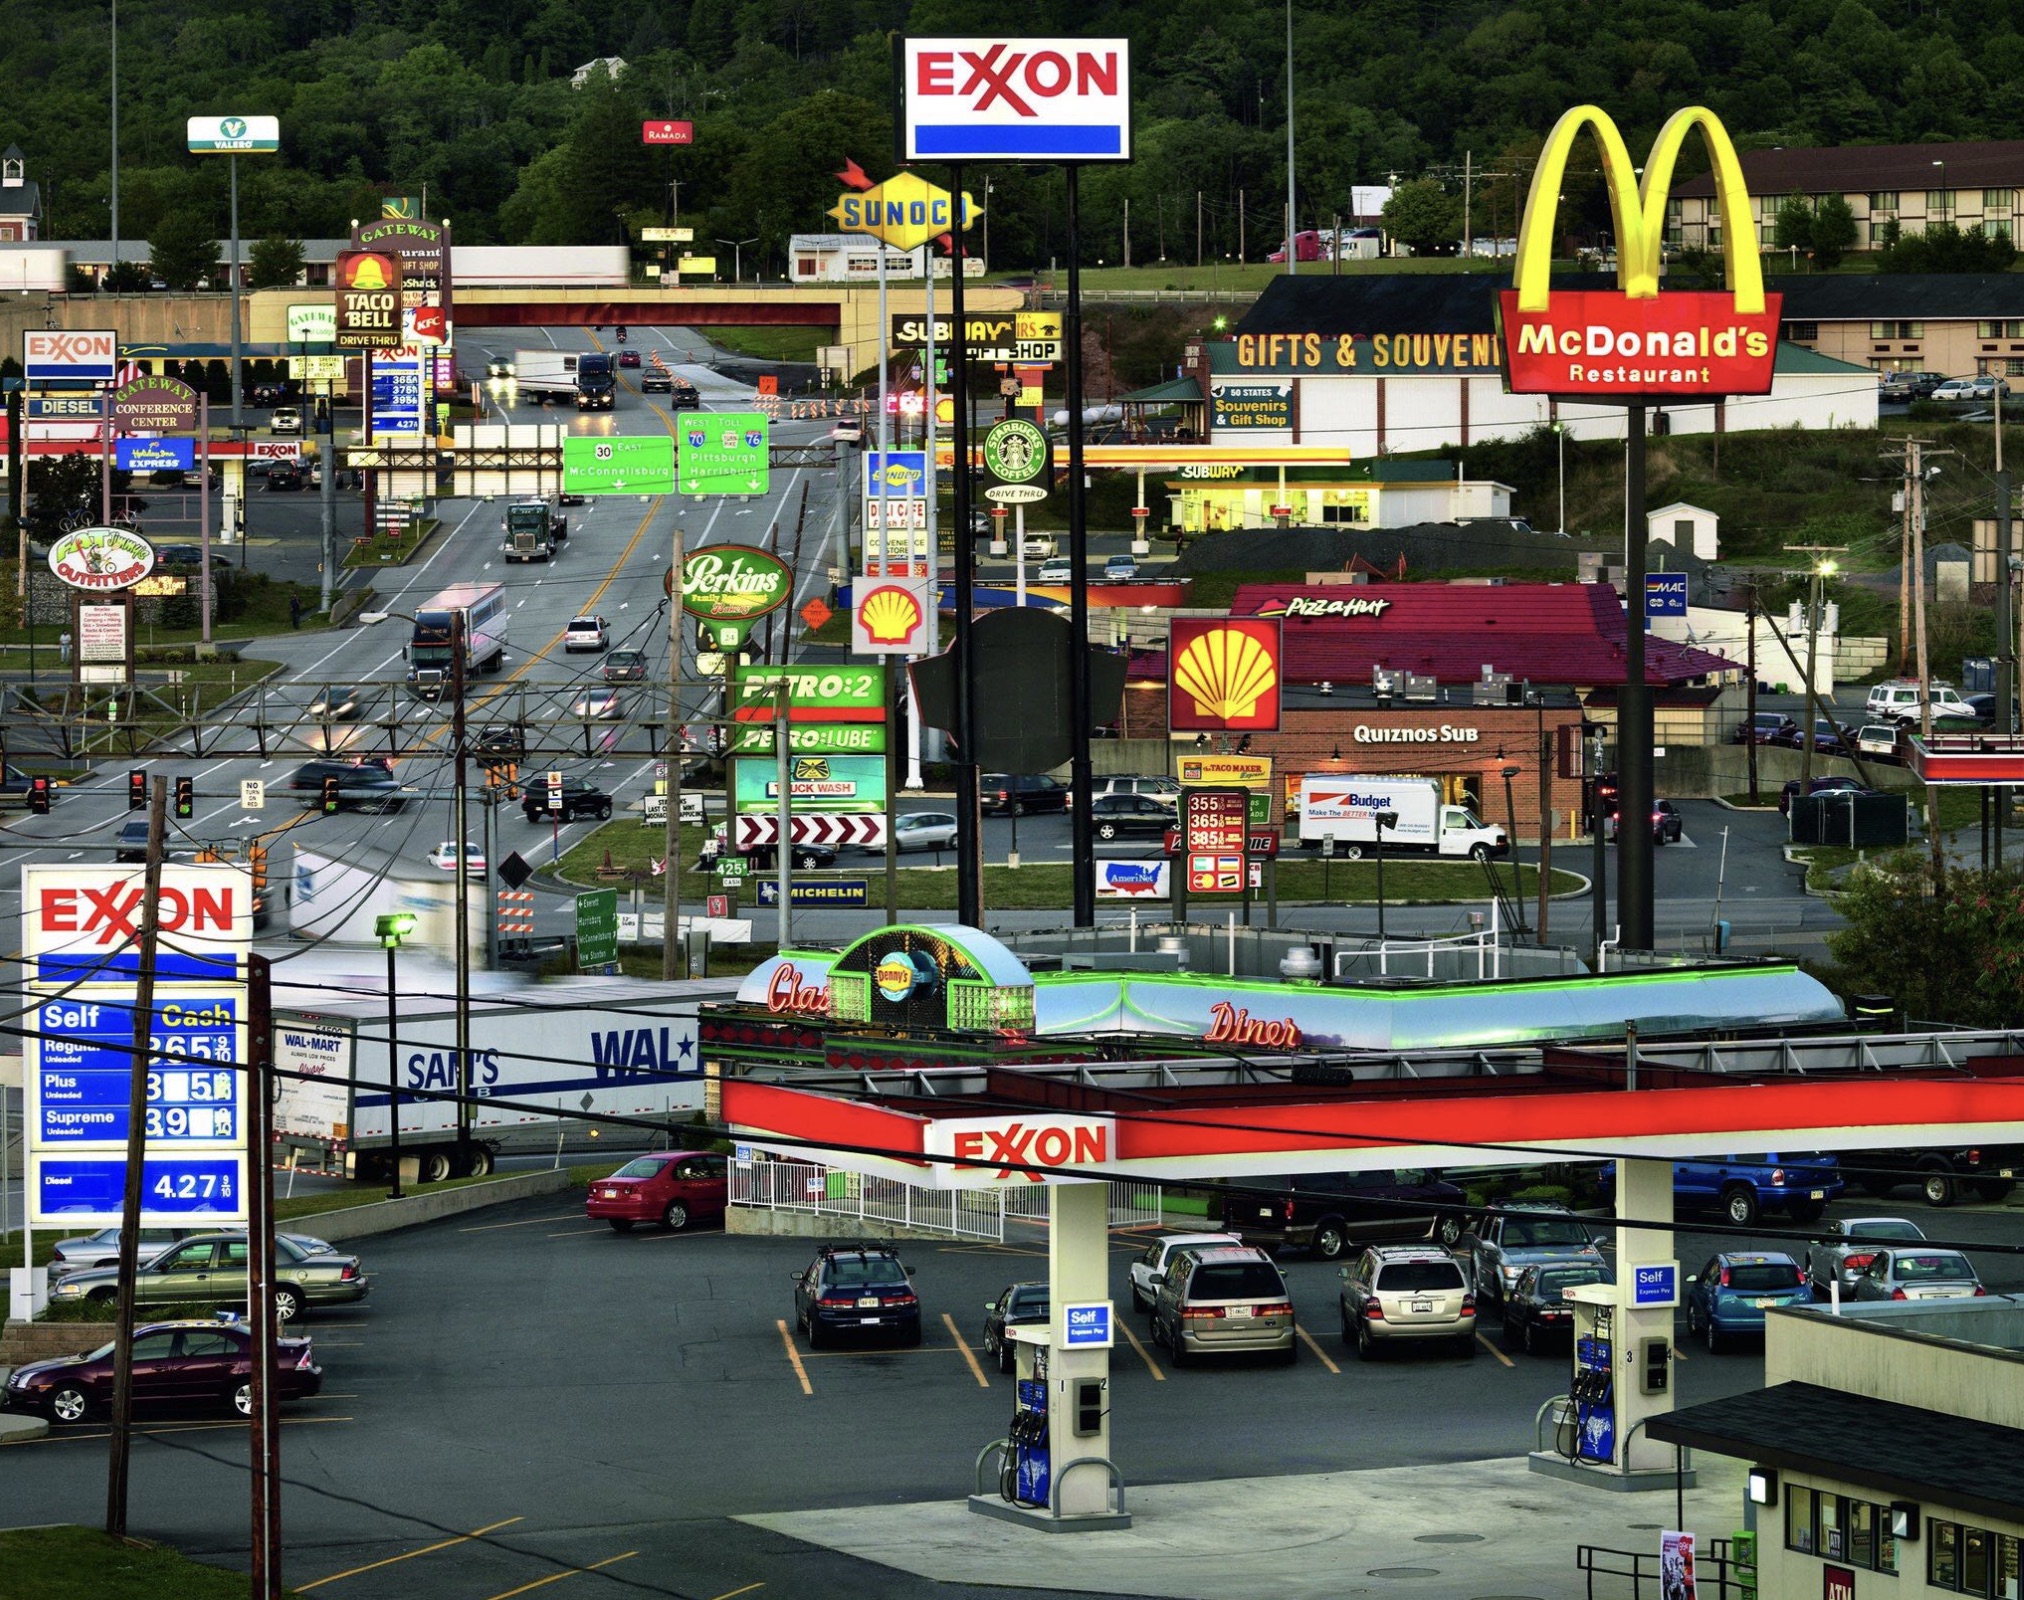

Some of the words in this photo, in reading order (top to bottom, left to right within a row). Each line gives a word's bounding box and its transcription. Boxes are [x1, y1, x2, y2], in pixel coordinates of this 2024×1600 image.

[917, 44, 1118, 117] EXXON
[648, 130, 687, 140] RAMADA
[214, 139, 253, 149] VALERO
[361, 223, 440, 243] GATEWAY
[419, 261, 438, 270] SHOP
[345, 293, 394, 311] TACO
[345, 311, 393, 328] BELL
[417, 316, 440, 331] KFC
[340, 336, 369, 345] DRIVE
[371, 336, 398, 345] THRU
[1517, 323, 1769, 357] McDonald's
[29, 334, 111, 363] EXXON
[1009, 343, 1055, 359] SHOP
[1237, 333, 1321, 367] GIFTS
[1336, 333, 1357, 367] &
[1569, 363, 1710, 385] Restaurant
[114, 377, 193, 402] GATEWAY
[1230, 389, 1241, 397] 50
[1243, 389, 1272, 397] STATES
[42, 401, 99, 413] DIESEL
[115, 403, 193, 414] CONFERENCE
[1215, 399, 1288, 412] Souvenirs
[131, 417, 177, 427] CENTER
[684, 418, 709, 426] WEST
[718, 418, 742, 427] TOLL
[1216, 414, 1226, 425] &
[1230, 414, 1252, 425] Gift
[1255, 414, 1287, 427] Shop
[690, 434, 703, 445] 70
[746, 434, 760, 445] 76
[988, 421, 1043, 449] STARBUCKS
[258, 444, 297, 458] EXXON
[596, 447, 611, 457] 30
[618, 443, 642, 451] EAST
[129, 459, 180, 468] EXPRESS
[691, 453, 756, 463] Pittsburgh
[570, 467, 669, 477] McConnellsburg
[690, 467, 757, 477] Harrisburg
[994, 464, 1037, 480] COFFEE
[1182, 465, 1245, 479] SUBWAY
[989, 490, 1015, 498] DRIVE
[1019, 490, 1044, 498] THRU
[56, 529, 110, 563] FAT
[107, 531, 150, 560] Jimmy's
[869, 539, 925, 547] COVENIECE
[57, 561, 146, 587] OUTFITTERS
[682, 554, 779, 594] Perkins
[1658, 582, 1686, 592] MAC
[1286, 597, 1343, 617] Pizza
[1343, 597, 1391, 617] Hut
[743, 729, 872, 748] PERO:LUBE
[1211, 765, 1231, 773] TACO
[1233, 765, 1262, 773] MAKER
[773, 783, 815, 793] TUCK
[817, 783, 851, 793] WASH
[1190, 797, 1218, 811] 355
[1350, 794, 1391, 809] Budget
[1190, 814, 1218, 828] 365
[1190, 831, 1218, 846] 385
[1111, 873, 1154, 883] AmeriNet
[41, 880, 232, 950] EXXON
[878, 970, 909, 983] Denny's
[44, 1005, 99, 1028] Self
[162, 1004, 231, 1027] Cash
[1203, 1001, 1301, 1047] Diner
[591, 1027, 679, 1079] WAL
[408, 1048, 499, 1090] SAM'S
[45, 1074, 76, 1087] Plus
[46, 1111, 114, 1125] Supreme
[953, 1123, 1107, 1182] EXXON
[154, 1174, 217, 1198] 4.27
[1639, 1271, 1663, 1283] Self
[1562, 1289, 1576, 1298] EXXON
[1071, 1311, 1096, 1324] Self
[1071, 1328, 1092, 1336] Express
[1093, 1328, 1105, 1336] Pay
[1626, 1350, 1633, 1363] 3
[1667, 1349, 1672, 1361] 4
[1101, 1378, 1107, 1391] 2
[1828, 1582, 1852, 1600] ATM
